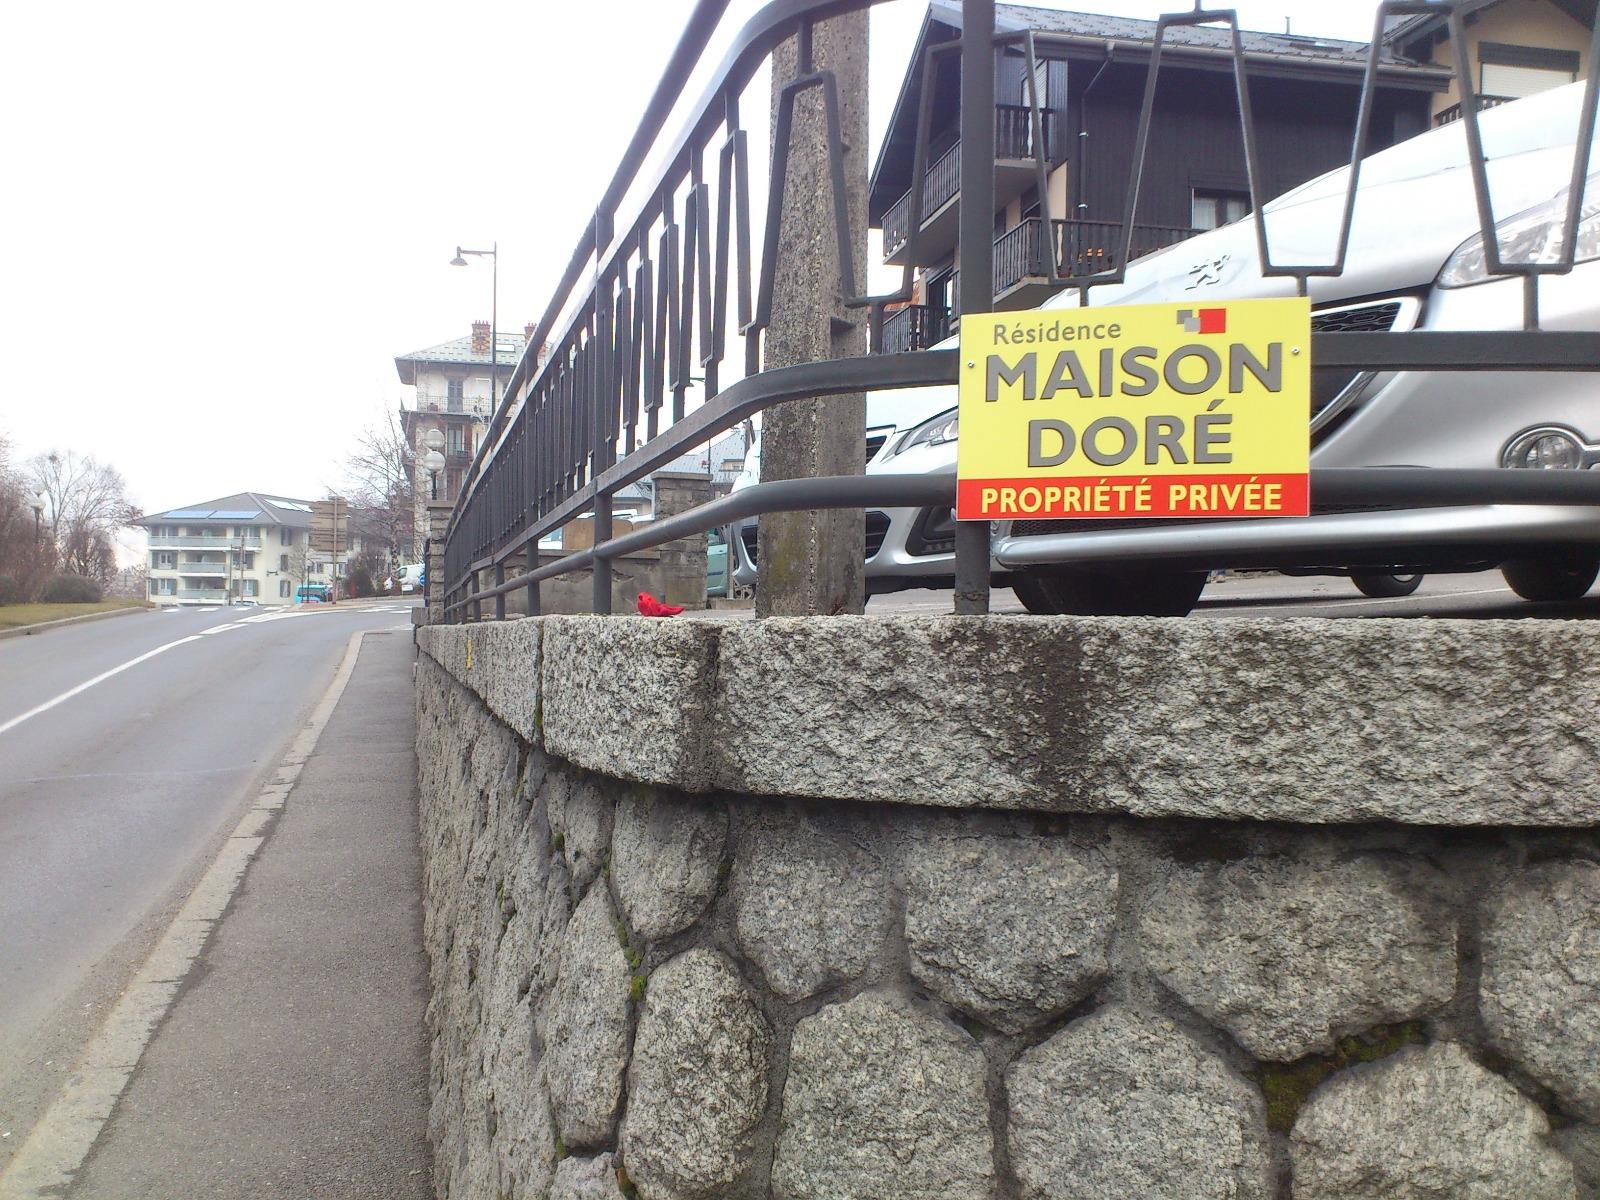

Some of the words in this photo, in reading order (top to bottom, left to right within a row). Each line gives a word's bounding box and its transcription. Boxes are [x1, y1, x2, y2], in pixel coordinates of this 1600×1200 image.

[993, 320, 1121, 346] Résidence
[985, 342, 1282, 402] MAISON
[1027, 399, 1233, 468] DORÉ
[981, 478, 1152, 514] PROPRIÉTÉ
[1169, 476, 1282, 511] PRIVÉE
